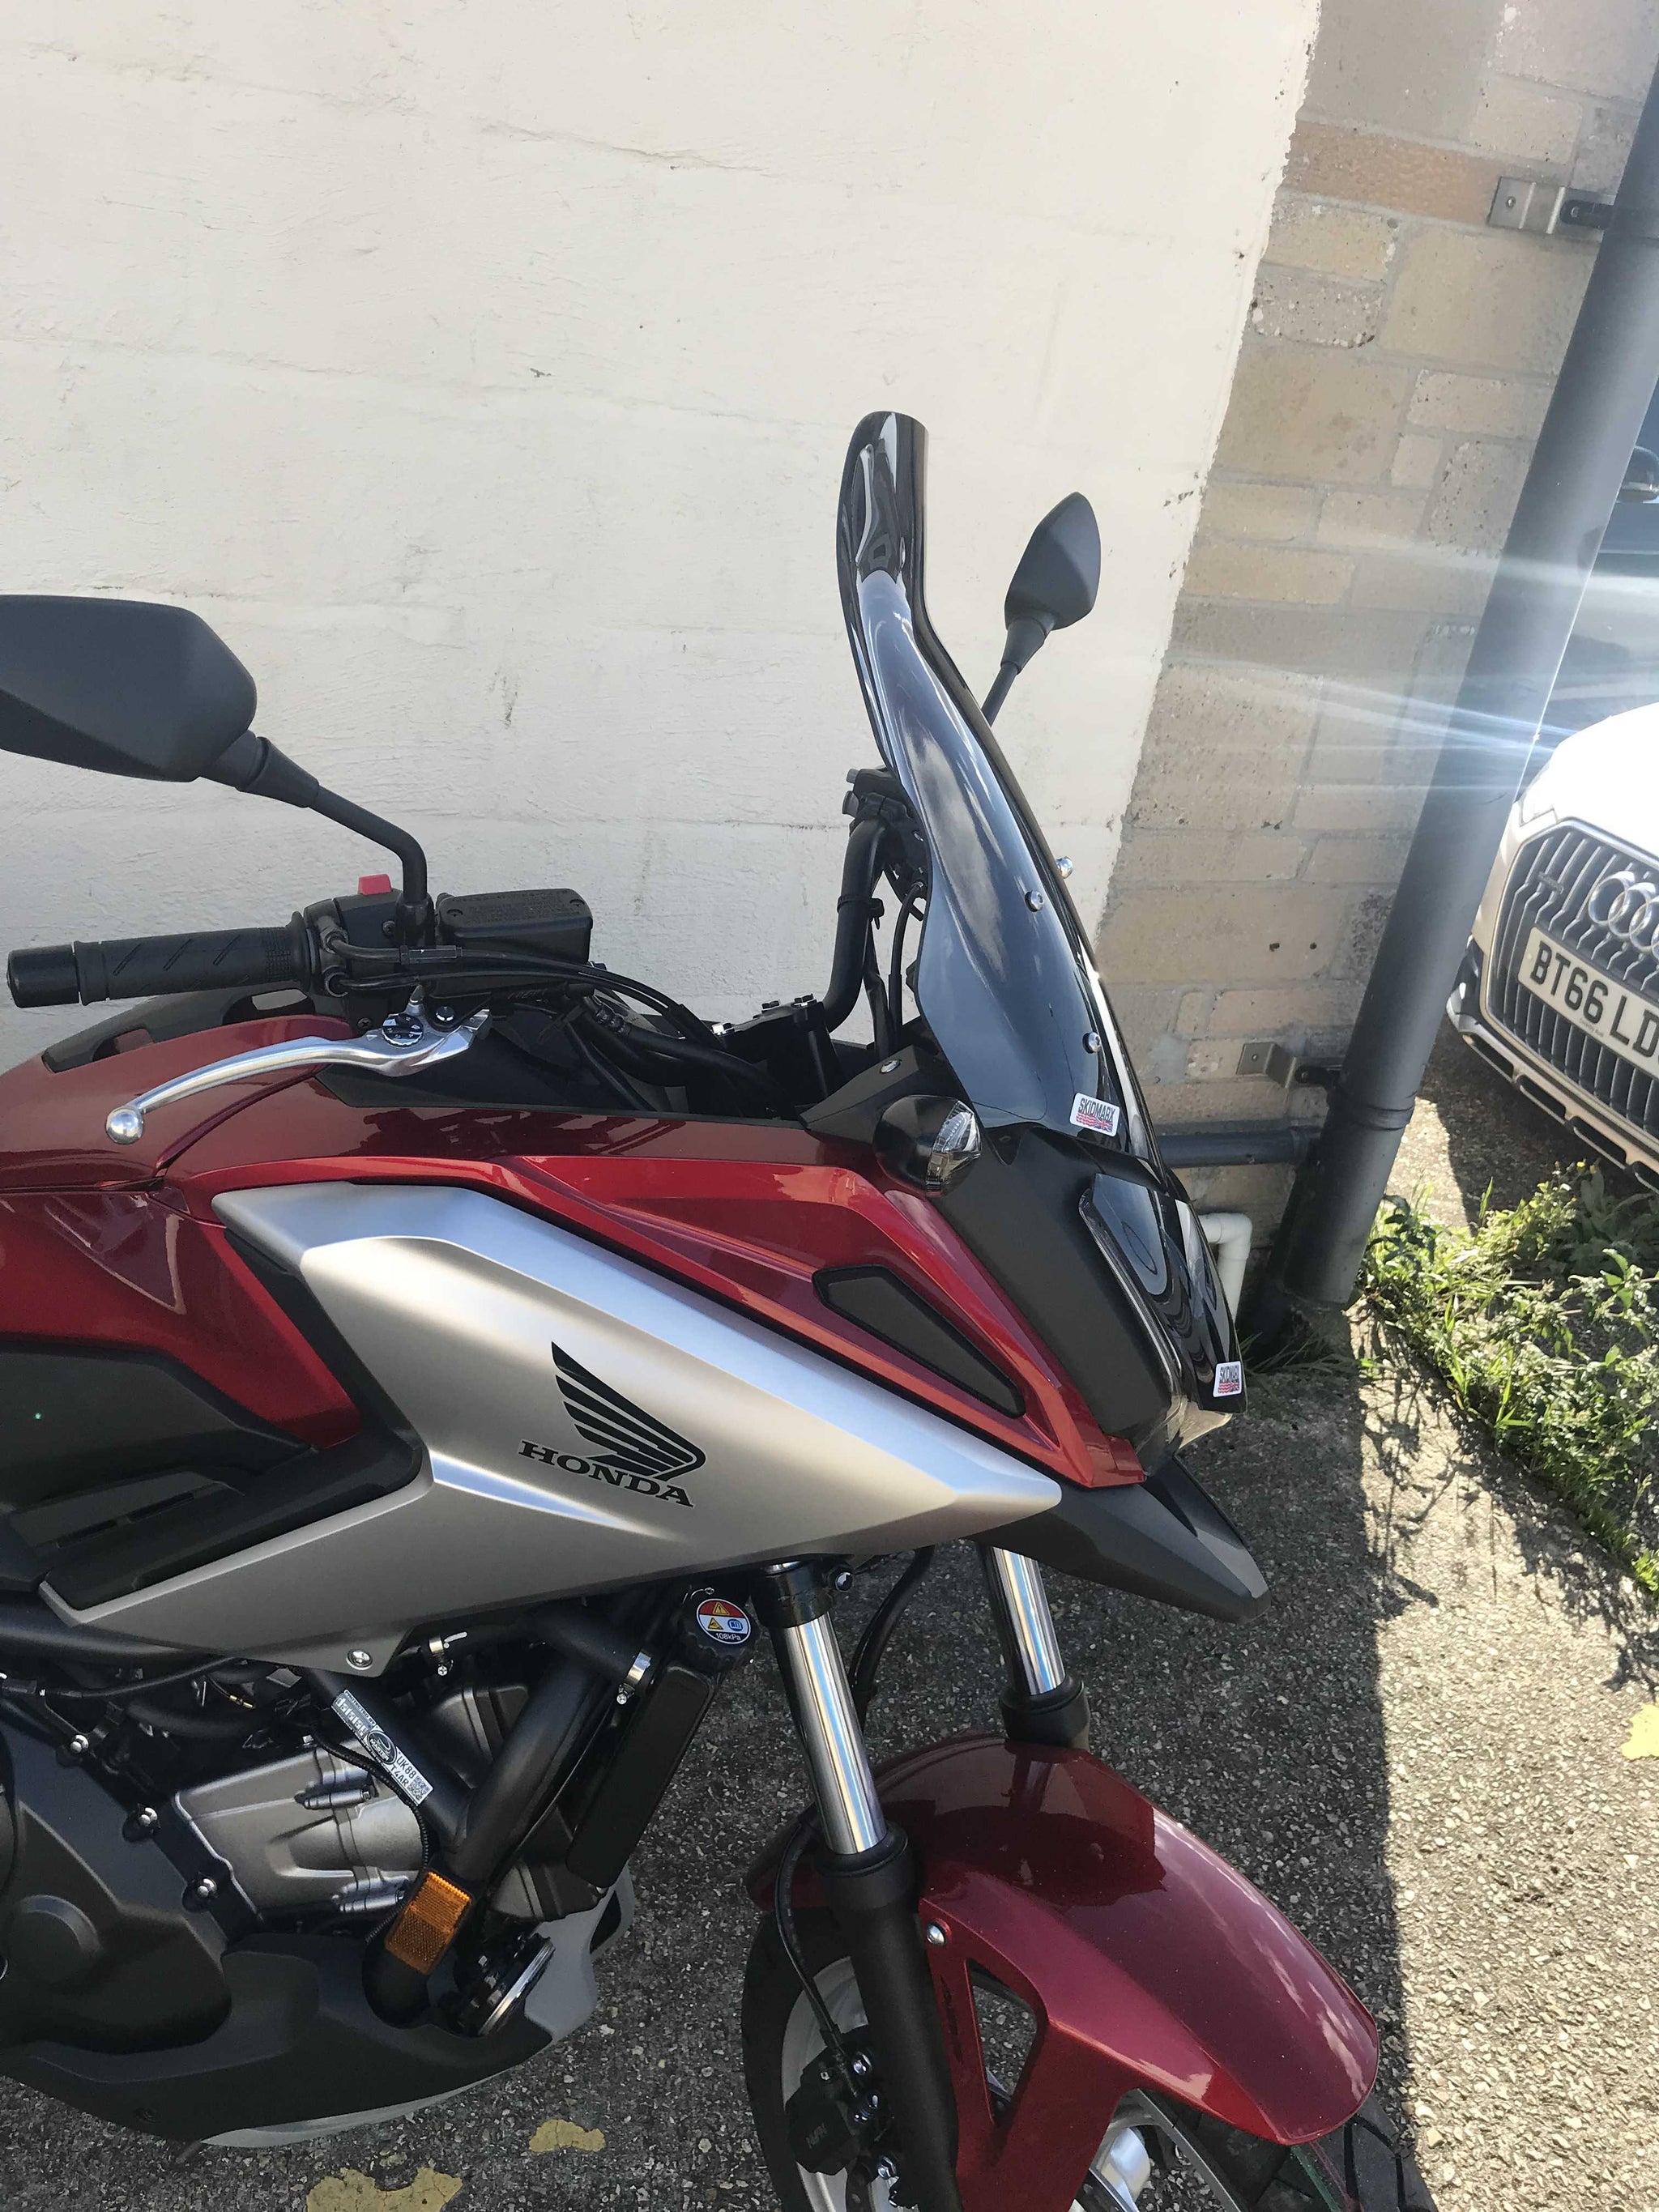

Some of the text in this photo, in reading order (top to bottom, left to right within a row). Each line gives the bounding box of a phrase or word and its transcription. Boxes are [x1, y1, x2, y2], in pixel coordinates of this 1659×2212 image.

[1530, 940, 1659, 1062] BT66 LD
[1078, 1097, 1116, 1123] SKIDMARX
[518, 1440, 693, 1507] HONDA
[715, 1632, 741, 1641] 108kPa
[369, 1738, 390, 1761] MASTER
[391, 1764, 408, 1785] T4AR
[396, 1755, 416, 1779] UK88
